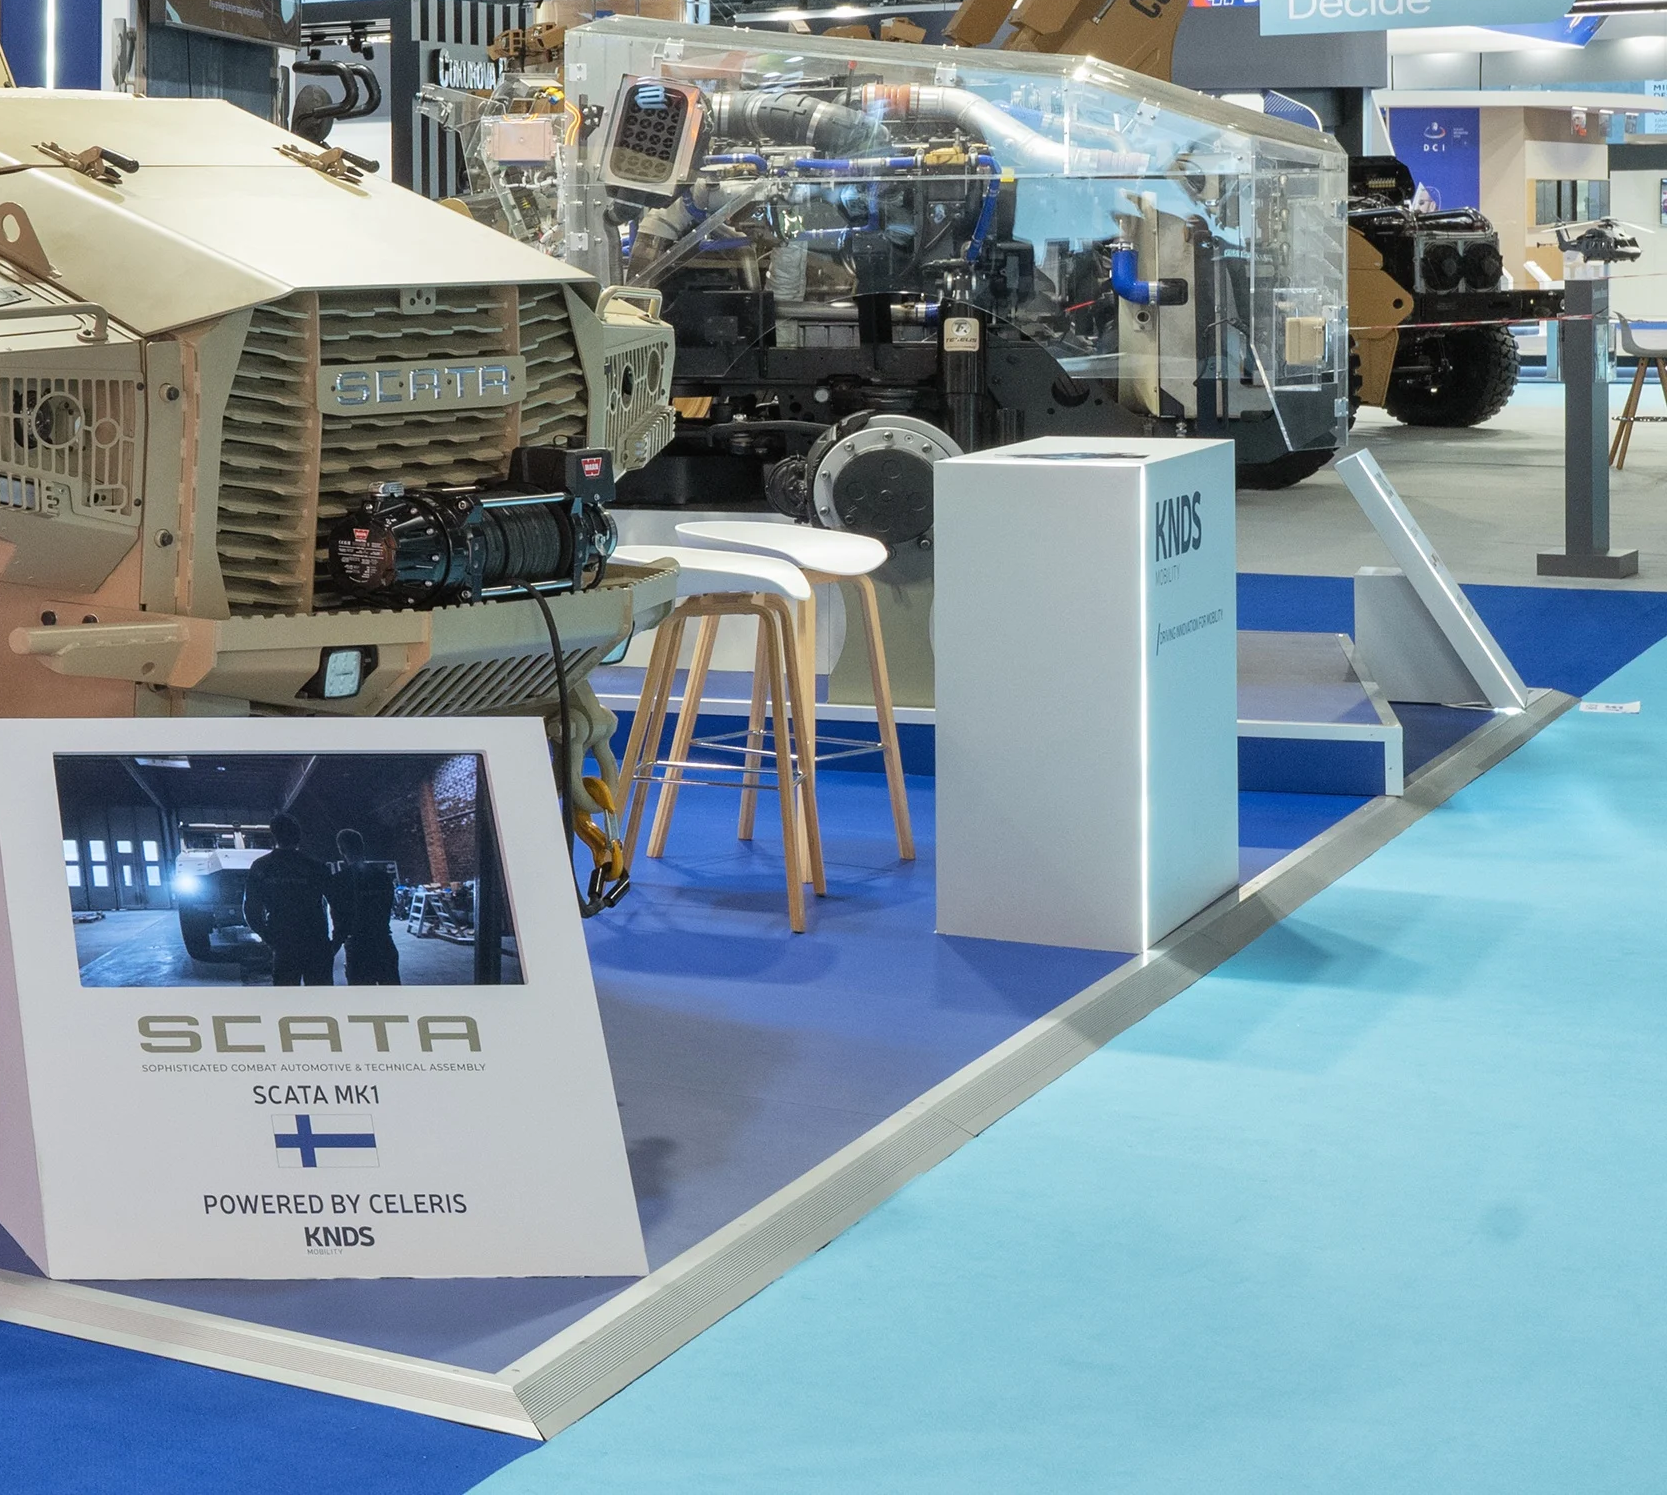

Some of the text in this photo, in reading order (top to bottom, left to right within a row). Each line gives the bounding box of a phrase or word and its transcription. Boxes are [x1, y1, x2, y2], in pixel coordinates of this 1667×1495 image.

[336, 364, 509, 405] SCATA
[1155, 491, 1202, 562] KNDS
[1155, 563, 1181, 586] MOBILITY
[137, 1015, 482, 1053] SCATA
[142, 1063, 486, 1073] SOPHISTICATED COMBAT AUTOMOTIVE & TECHNICAL ASSEMBLY
[253, 1085, 380, 1105] SCATA MK1
[203, 1194, 468, 1215] POWERED BY CELERIS
[304, 1226, 375, 1247] KNDS
[307, 1248, 343, 1256] MOBILITY
